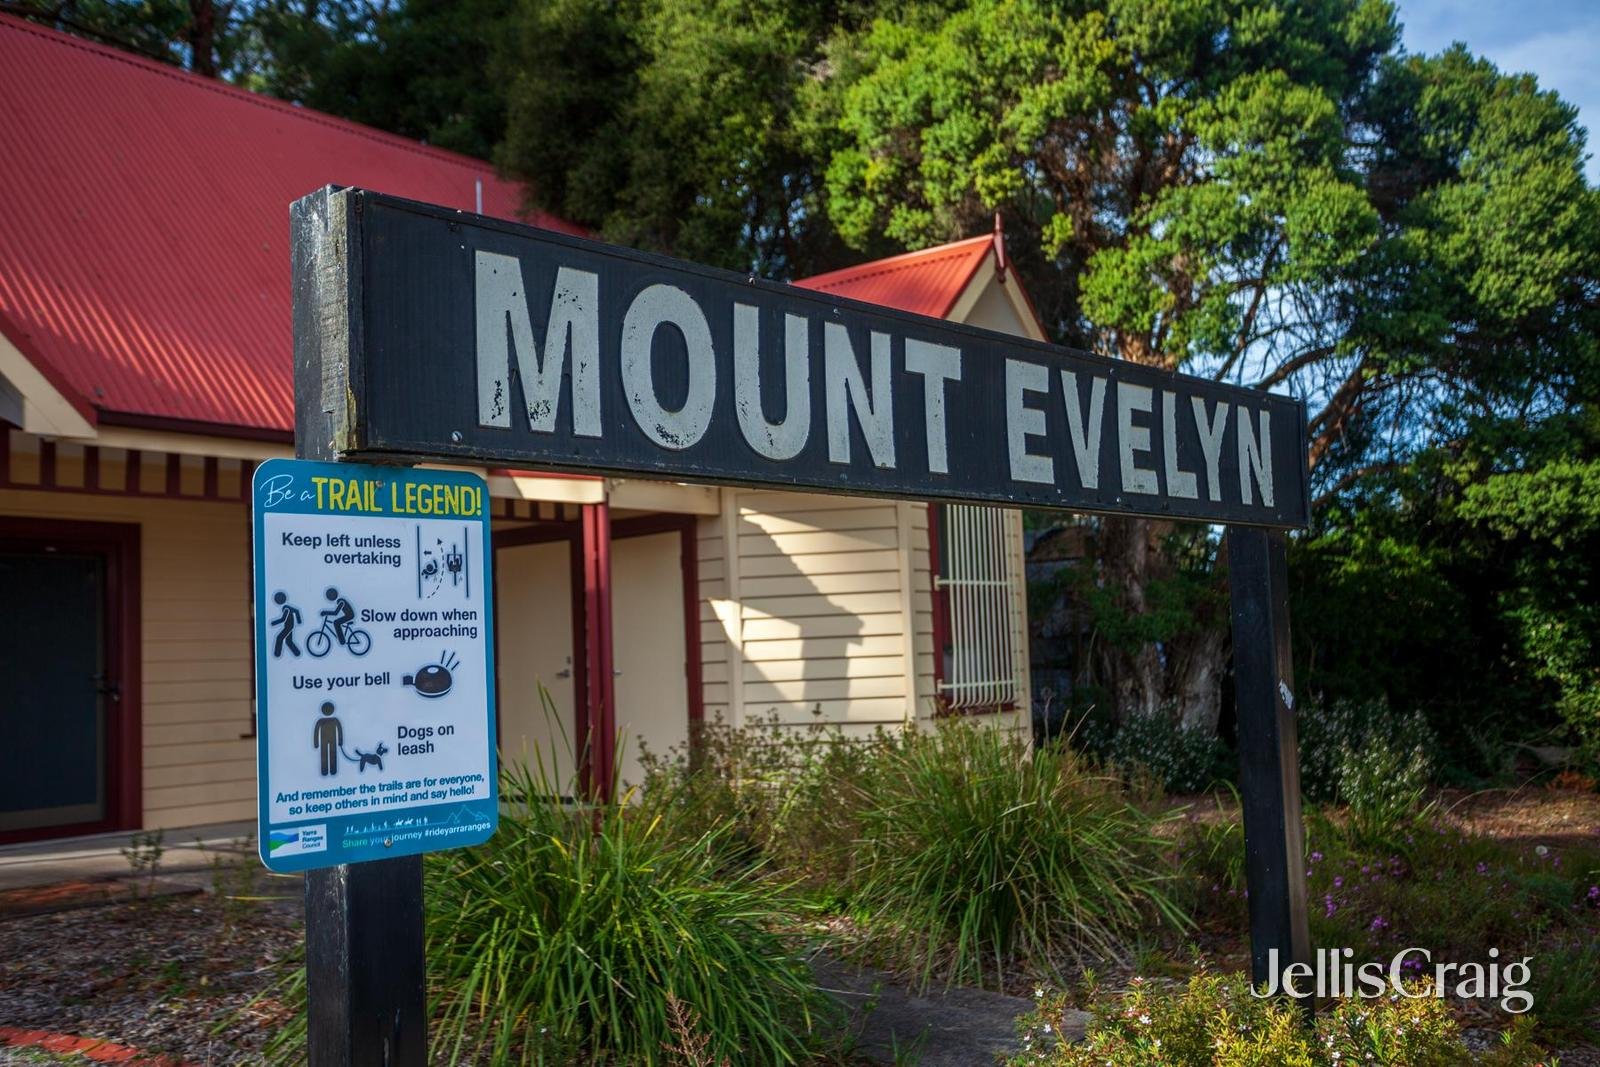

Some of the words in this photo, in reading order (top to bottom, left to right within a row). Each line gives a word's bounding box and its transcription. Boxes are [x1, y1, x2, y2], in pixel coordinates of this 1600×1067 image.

[475, 250, 962, 475] MOUNT
[1004, 357, 1275, 508] EVELYN
[260, 474, 295, 507] Be
[300, 489, 315, 501] a
[311, 477, 383, 512] TRAIL
[391, 481, 482, 516] LEGEND!
[281, 532, 322, 549] Keep
[326, 533, 350, 547] left
[355, 535, 401, 548] unless
[324, 552, 401, 567] overtaking
[361, 609, 396, 623] Slow
[401, 609, 438, 622] down
[442, 609, 477, 621] when
[393, 624, 478, 641] approaching
[292, 675, 323, 689] Use
[327, 675, 360, 690] your
[364, 672, 390, 686] bell
[397, 725, 434, 741] Dogs
[437, 724, 455, 735] on
[397, 741, 435, 756] leash
[275, 791, 299, 803] And
[301, 784, 356, 801] remember
[359, 782, 376, 793] the
[378, 780, 403, 791] trails
[405, 779, 421, 789] are
[423, 776, 437, 787] for
[439, 772, 485, 786] everyone,
[288, 806, 303, 815] so
[305, 800, 332, 814] keep
[335, 797, 369, 810] others
[371, 795, 380, 805] in
[382, 793, 408, 805] mind
[410, 790, 428, 801] and
[430, 788, 447, 800] say
[450, 785, 475, 797] hello!
[342, 839, 368, 849] Share
[391, 830, 423, 842] journey
[424, 821, 492, 837] #rideyarraranges
